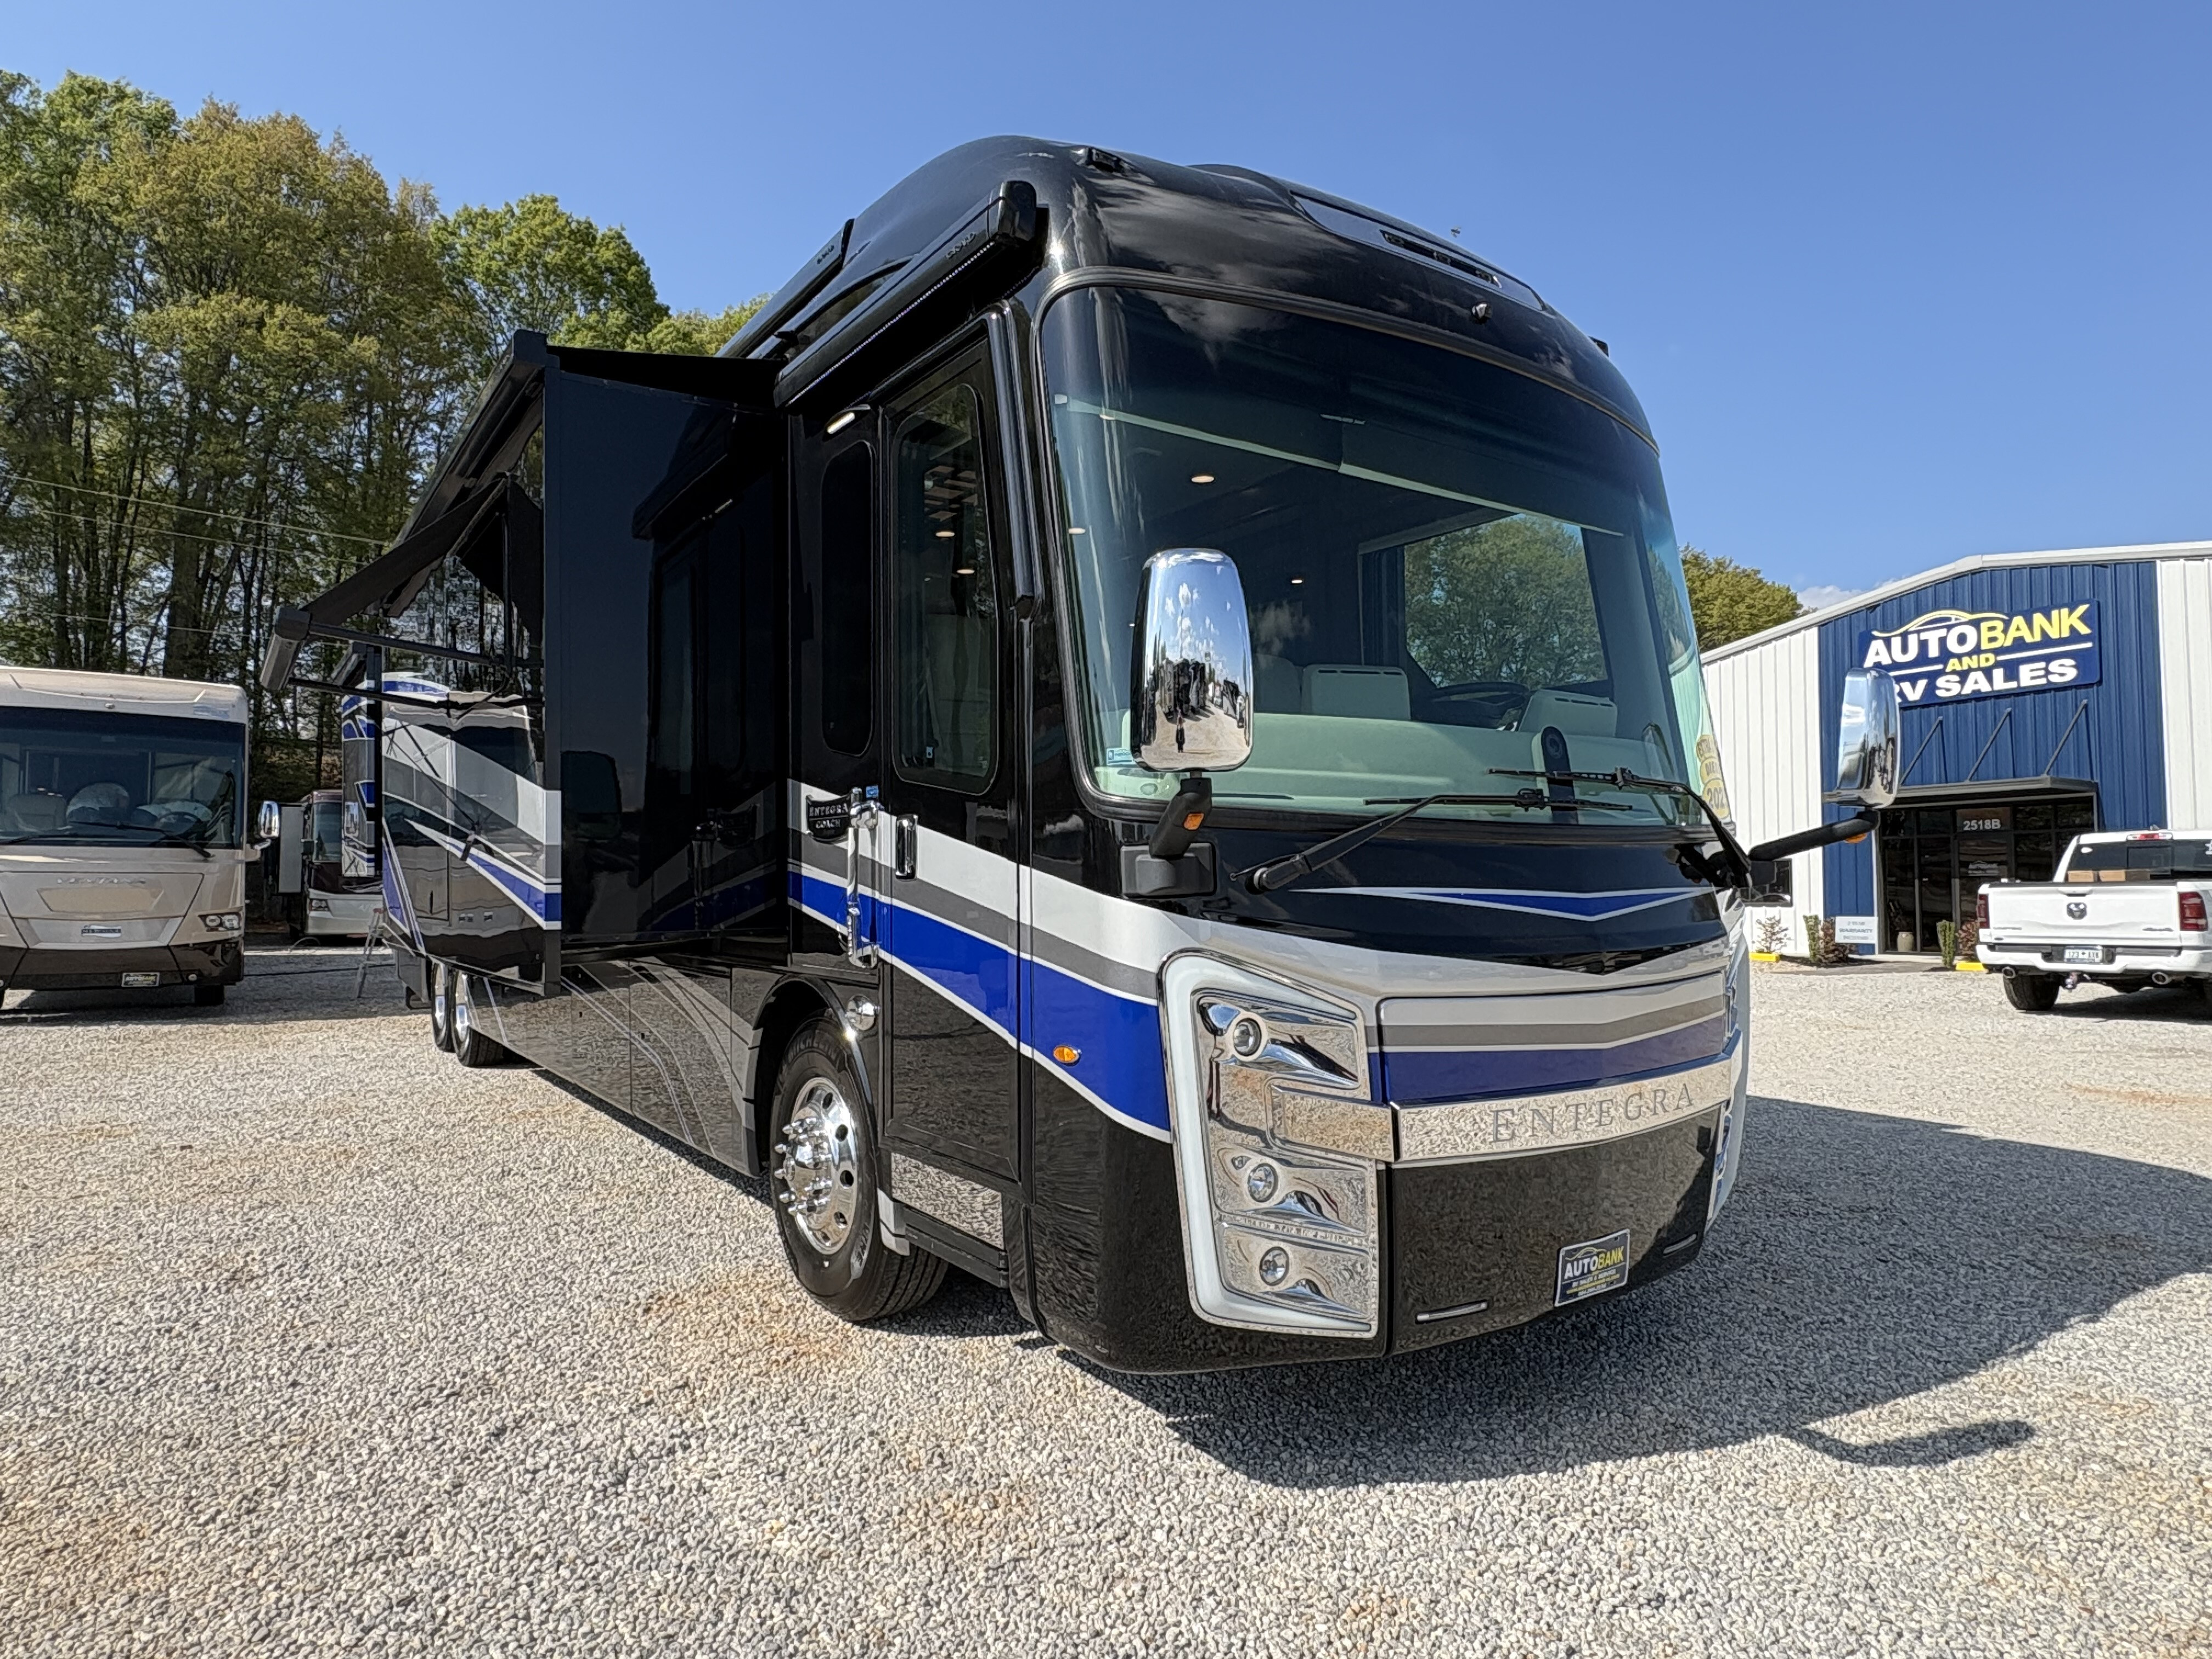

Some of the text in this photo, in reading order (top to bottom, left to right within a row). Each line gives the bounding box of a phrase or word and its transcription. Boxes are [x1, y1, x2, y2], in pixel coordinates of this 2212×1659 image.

[1863, 603, 2093, 668] AUTOBANK
[1945, 653, 1997, 673] AND
[1935, 658, 2078, 698] SALES
[809, 803, 848, 816] ENTEGRA
[815, 819, 840, 828] COACH
[1963, 819, 2001, 831] 2518B
[1492, 1083, 1693, 1143] ENTEGRA
[1564, 1245, 1624, 1279] AUTOBANK
